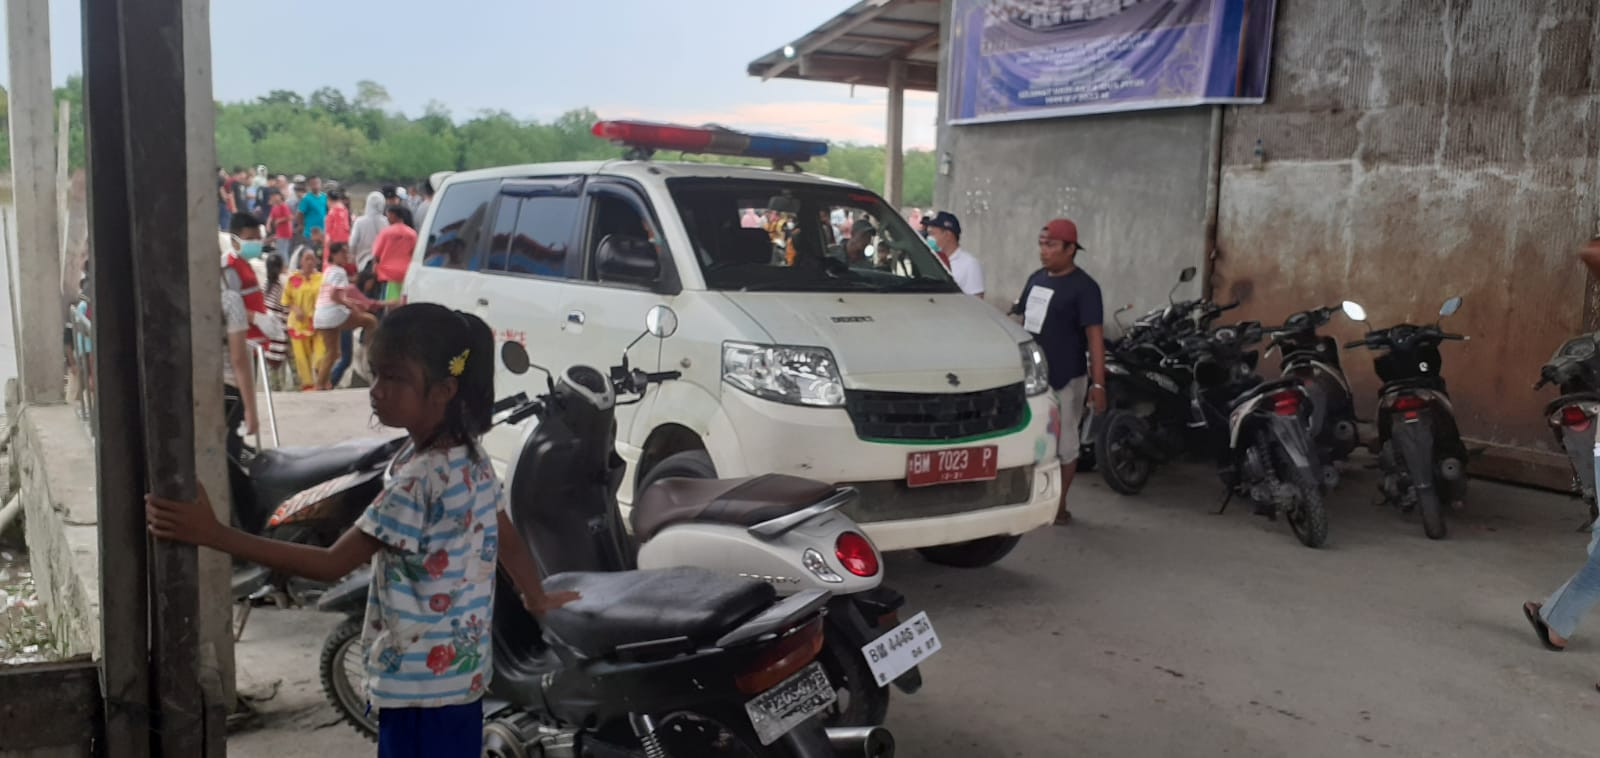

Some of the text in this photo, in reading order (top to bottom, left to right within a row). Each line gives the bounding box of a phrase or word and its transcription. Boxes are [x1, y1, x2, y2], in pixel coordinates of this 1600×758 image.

[914, 448, 992, 474] BM 7023 P
[868, 643, 888, 663] BM
